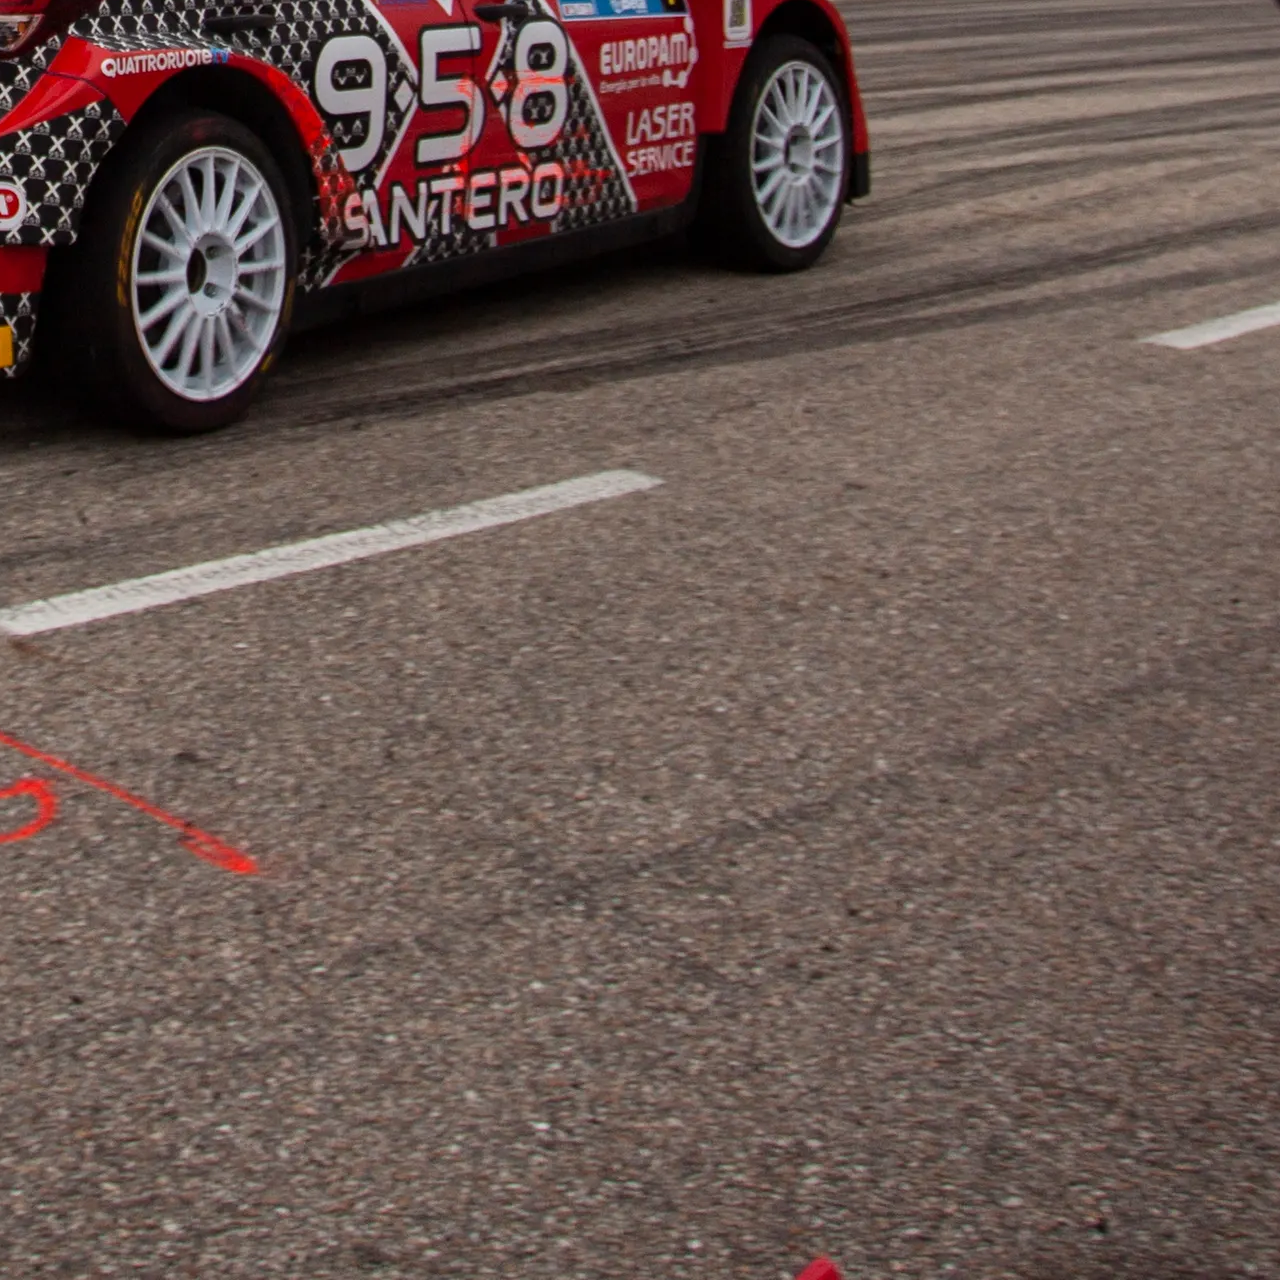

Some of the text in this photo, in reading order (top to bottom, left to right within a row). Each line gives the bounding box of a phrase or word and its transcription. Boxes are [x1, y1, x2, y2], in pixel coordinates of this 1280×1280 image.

[600, 33, 688, 75] EUROPAM
[627, 102, 695, 145] LASER
[626, 141, 694, 177] SERVICE
[339, 161, 566, 251] SANTERO
